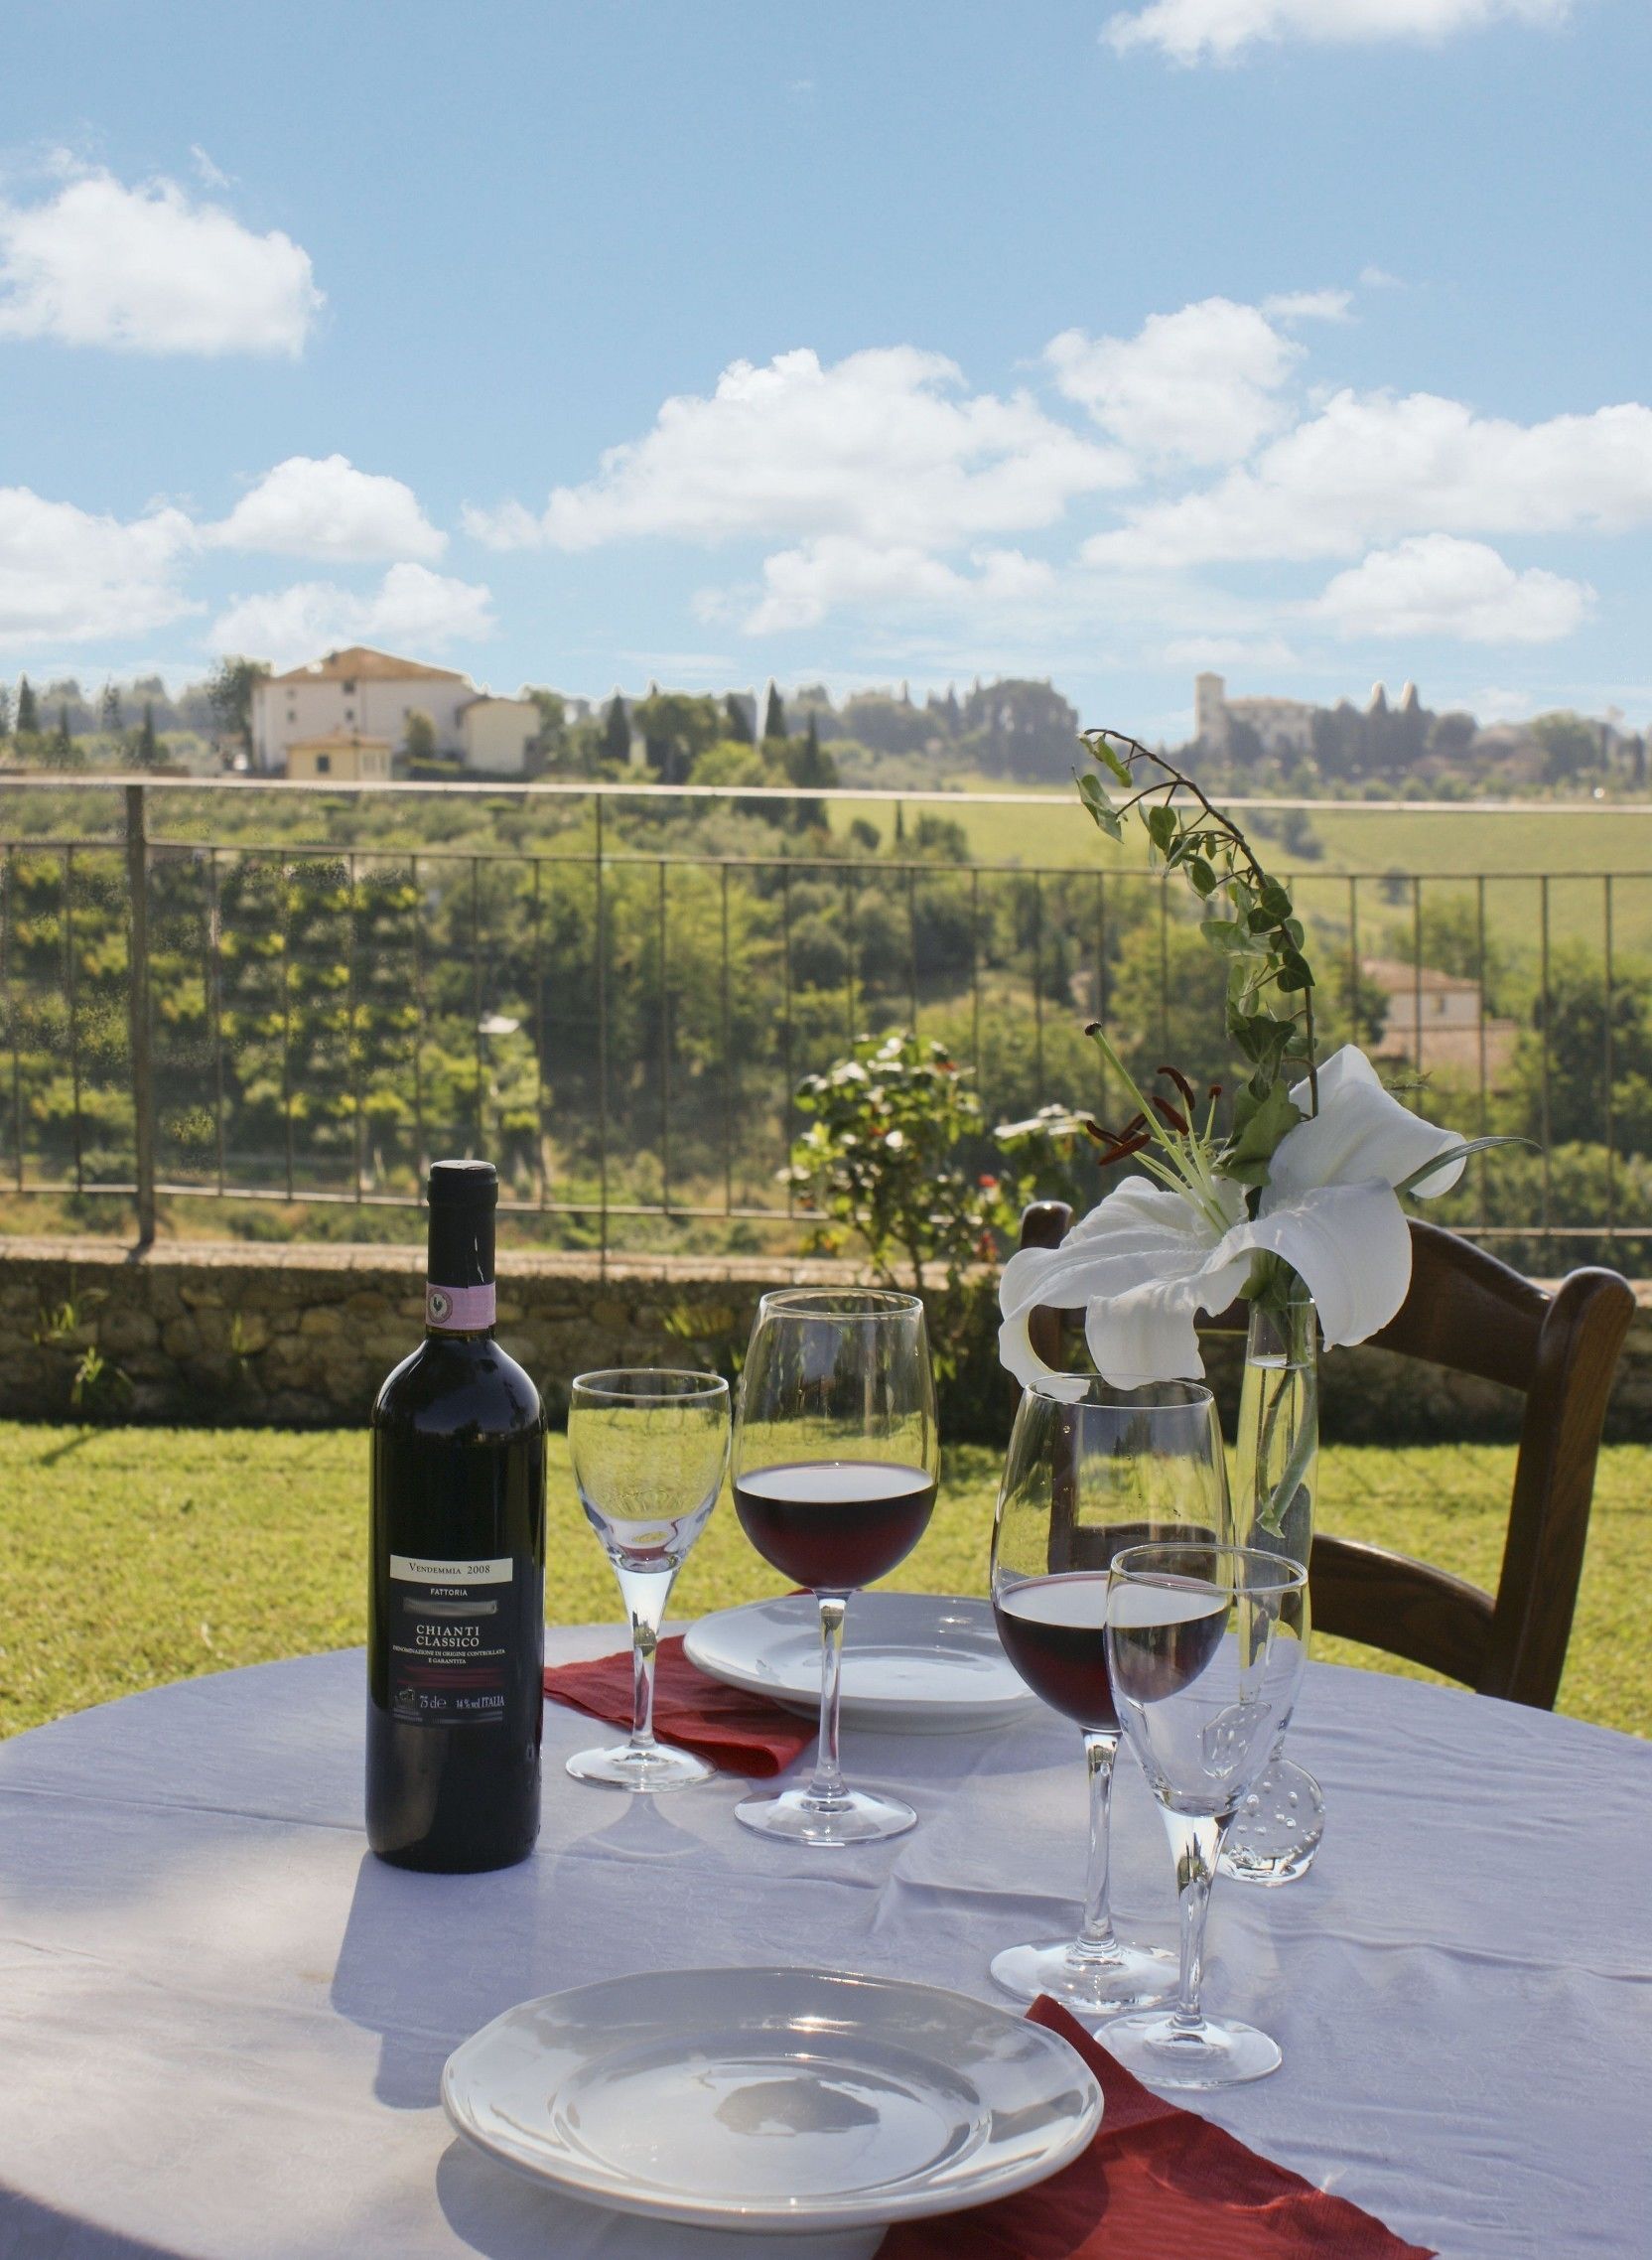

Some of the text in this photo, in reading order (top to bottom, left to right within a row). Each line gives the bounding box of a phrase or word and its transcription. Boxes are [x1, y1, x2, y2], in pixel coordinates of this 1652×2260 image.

[408, 1562, 490, 1575] VENDEMMIA 2008
[430, 1588, 469, 1597] FATTORIA
[416, 1624, 480, 1636] CHIANTI
[416, 1635, 480, 1647] CLASSICO
[467, 1648, 506, 1657] CONTROLLATA
[482, 1695, 505, 1707] ITALIA
